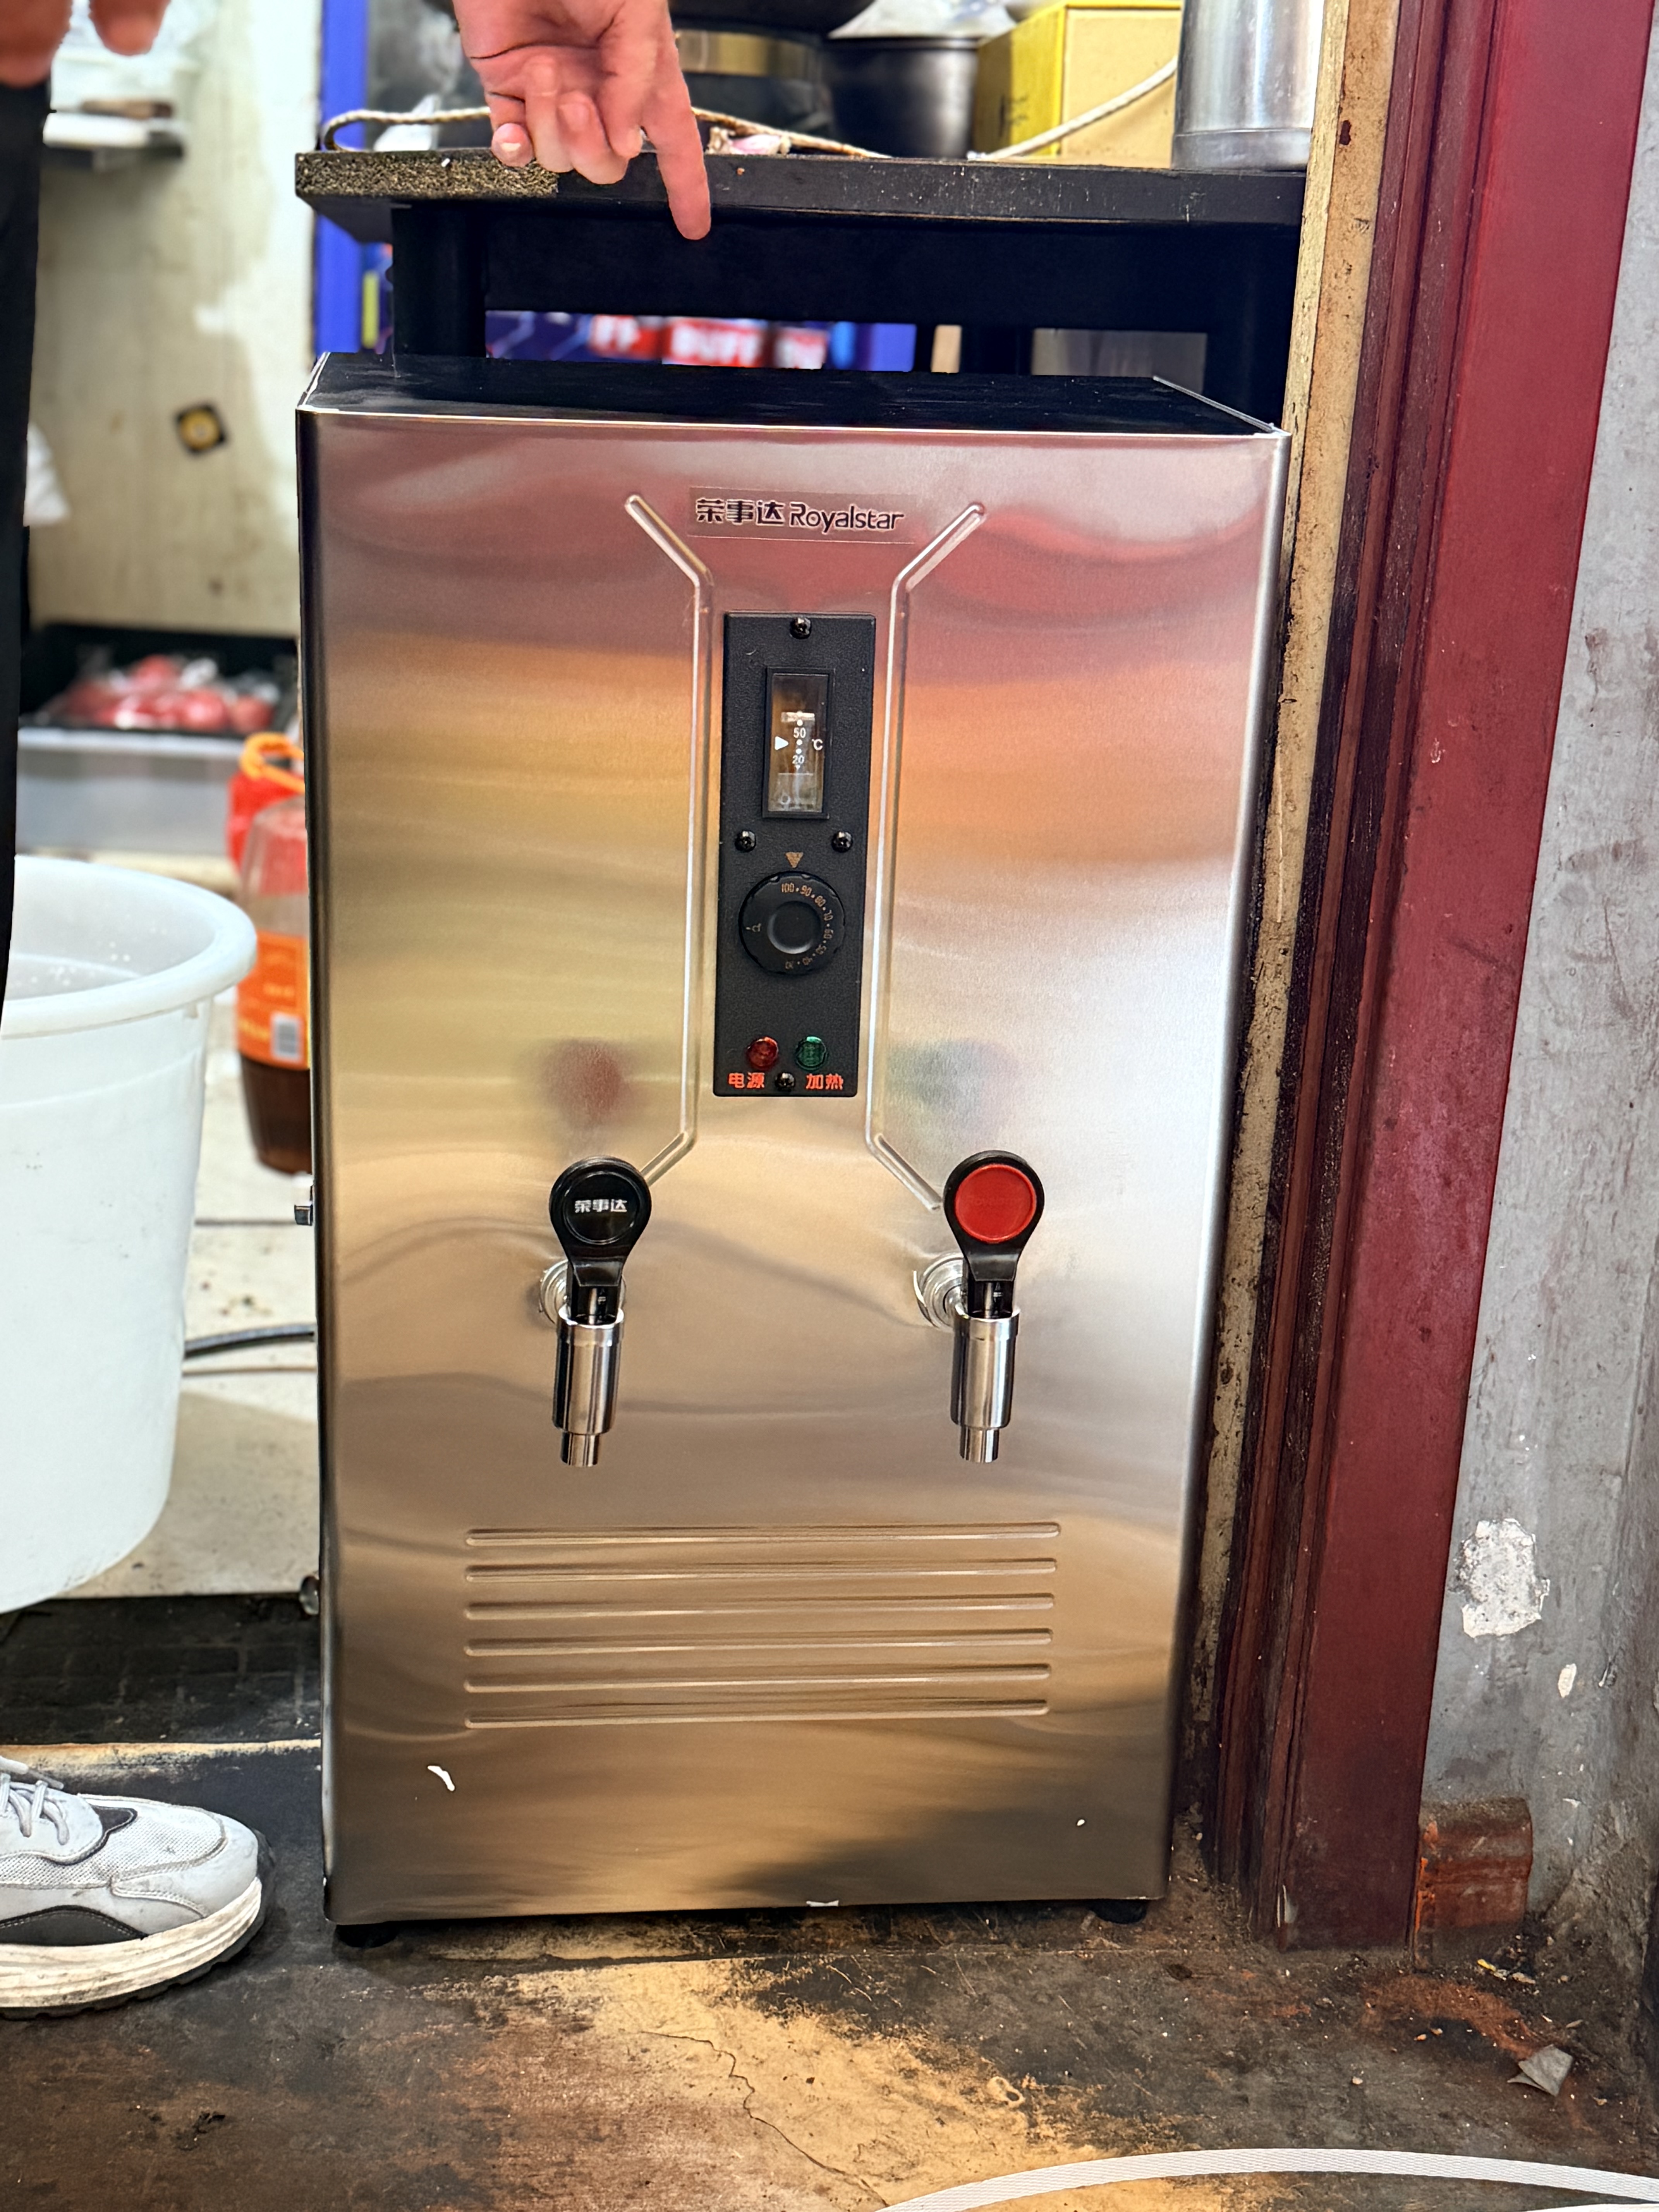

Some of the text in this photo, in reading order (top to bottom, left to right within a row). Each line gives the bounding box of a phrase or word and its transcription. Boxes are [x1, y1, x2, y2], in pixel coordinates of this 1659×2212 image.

[696, 498, 905, 533] 荣事达 Royalstar
[793, 727, 806, 738] 50
[792, 755, 804, 764] 20
[781, 883, 794, 893] 100
[800, 885, 812, 896] 90
[728, 1072, 843, 1090] 电源 加热
[575, 1199, 627, 1213] 荣事达
